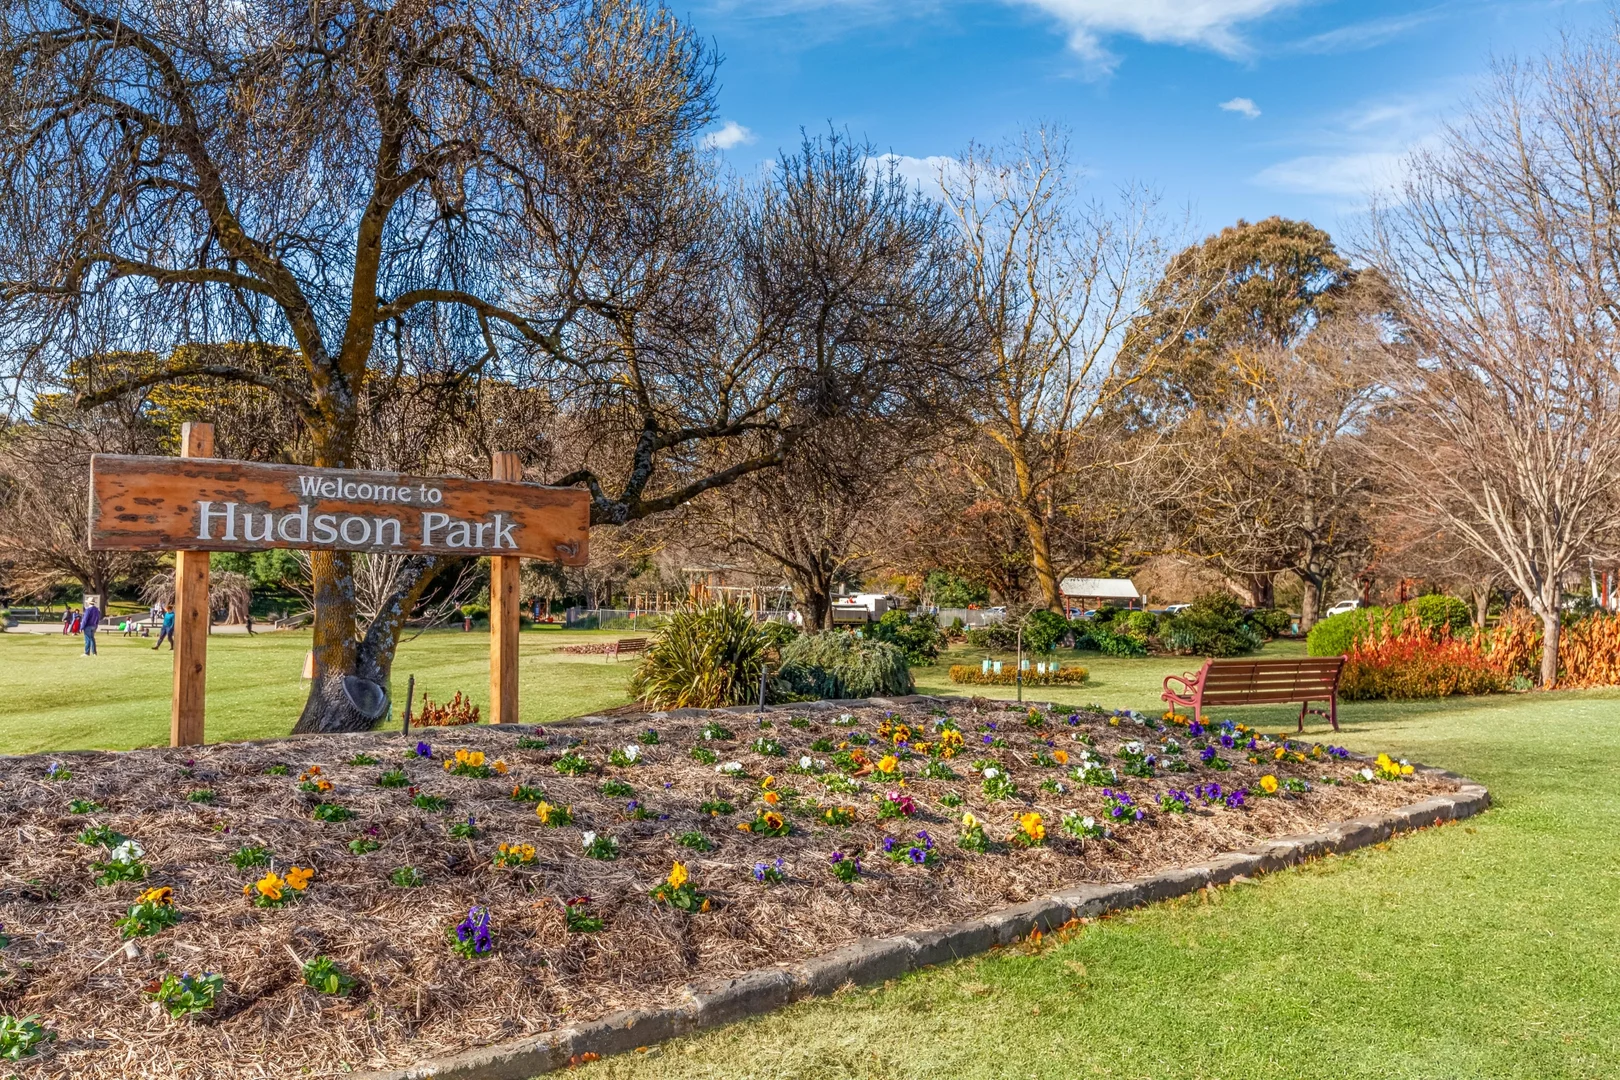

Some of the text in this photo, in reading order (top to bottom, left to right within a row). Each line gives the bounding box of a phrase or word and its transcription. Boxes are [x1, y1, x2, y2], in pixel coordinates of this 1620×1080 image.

[299, 475, 442, 503] Welcome to
[197, 500, 518, 549] Hudson Park
